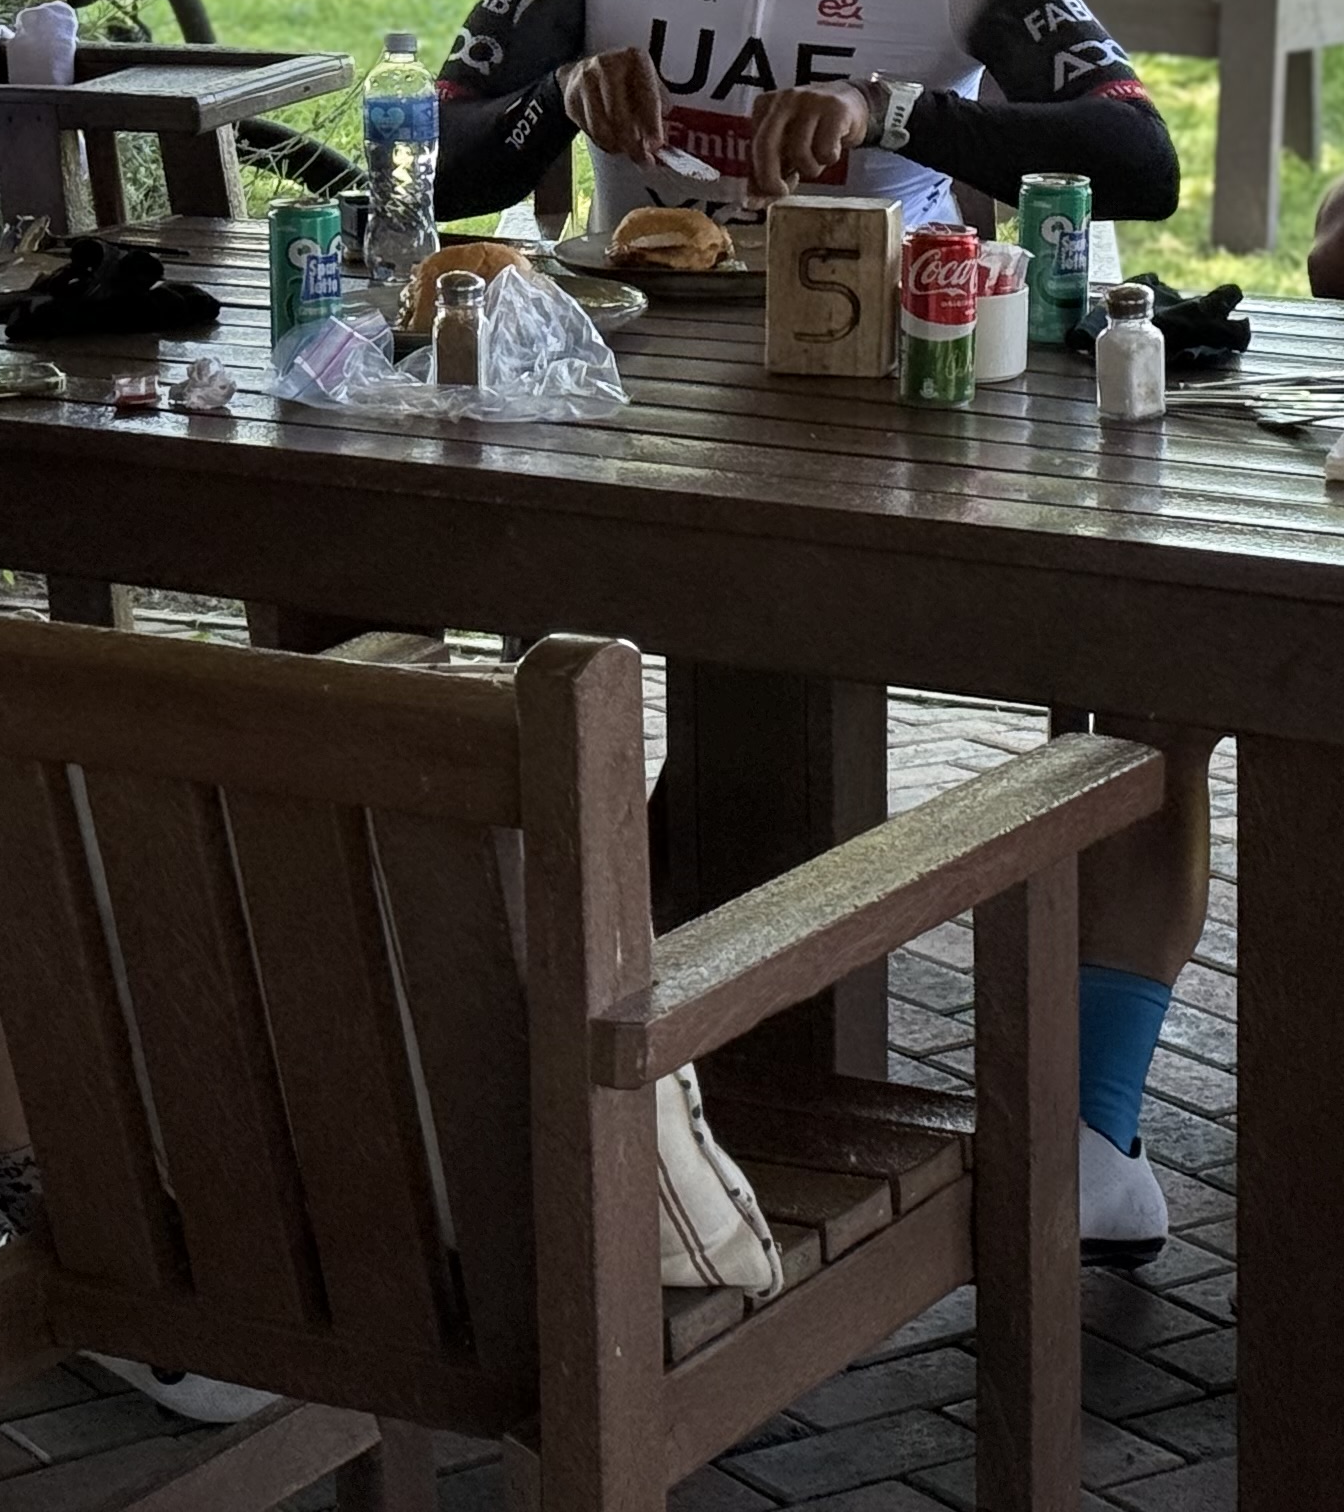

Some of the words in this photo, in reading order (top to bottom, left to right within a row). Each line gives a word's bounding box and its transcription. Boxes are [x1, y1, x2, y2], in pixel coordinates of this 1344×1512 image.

[649, 16, 856, 100] UAE
[667, 120, 750, 161] Emir
[794, 247, 861, 344] 5
[909, 248, 978, 296] Coca
